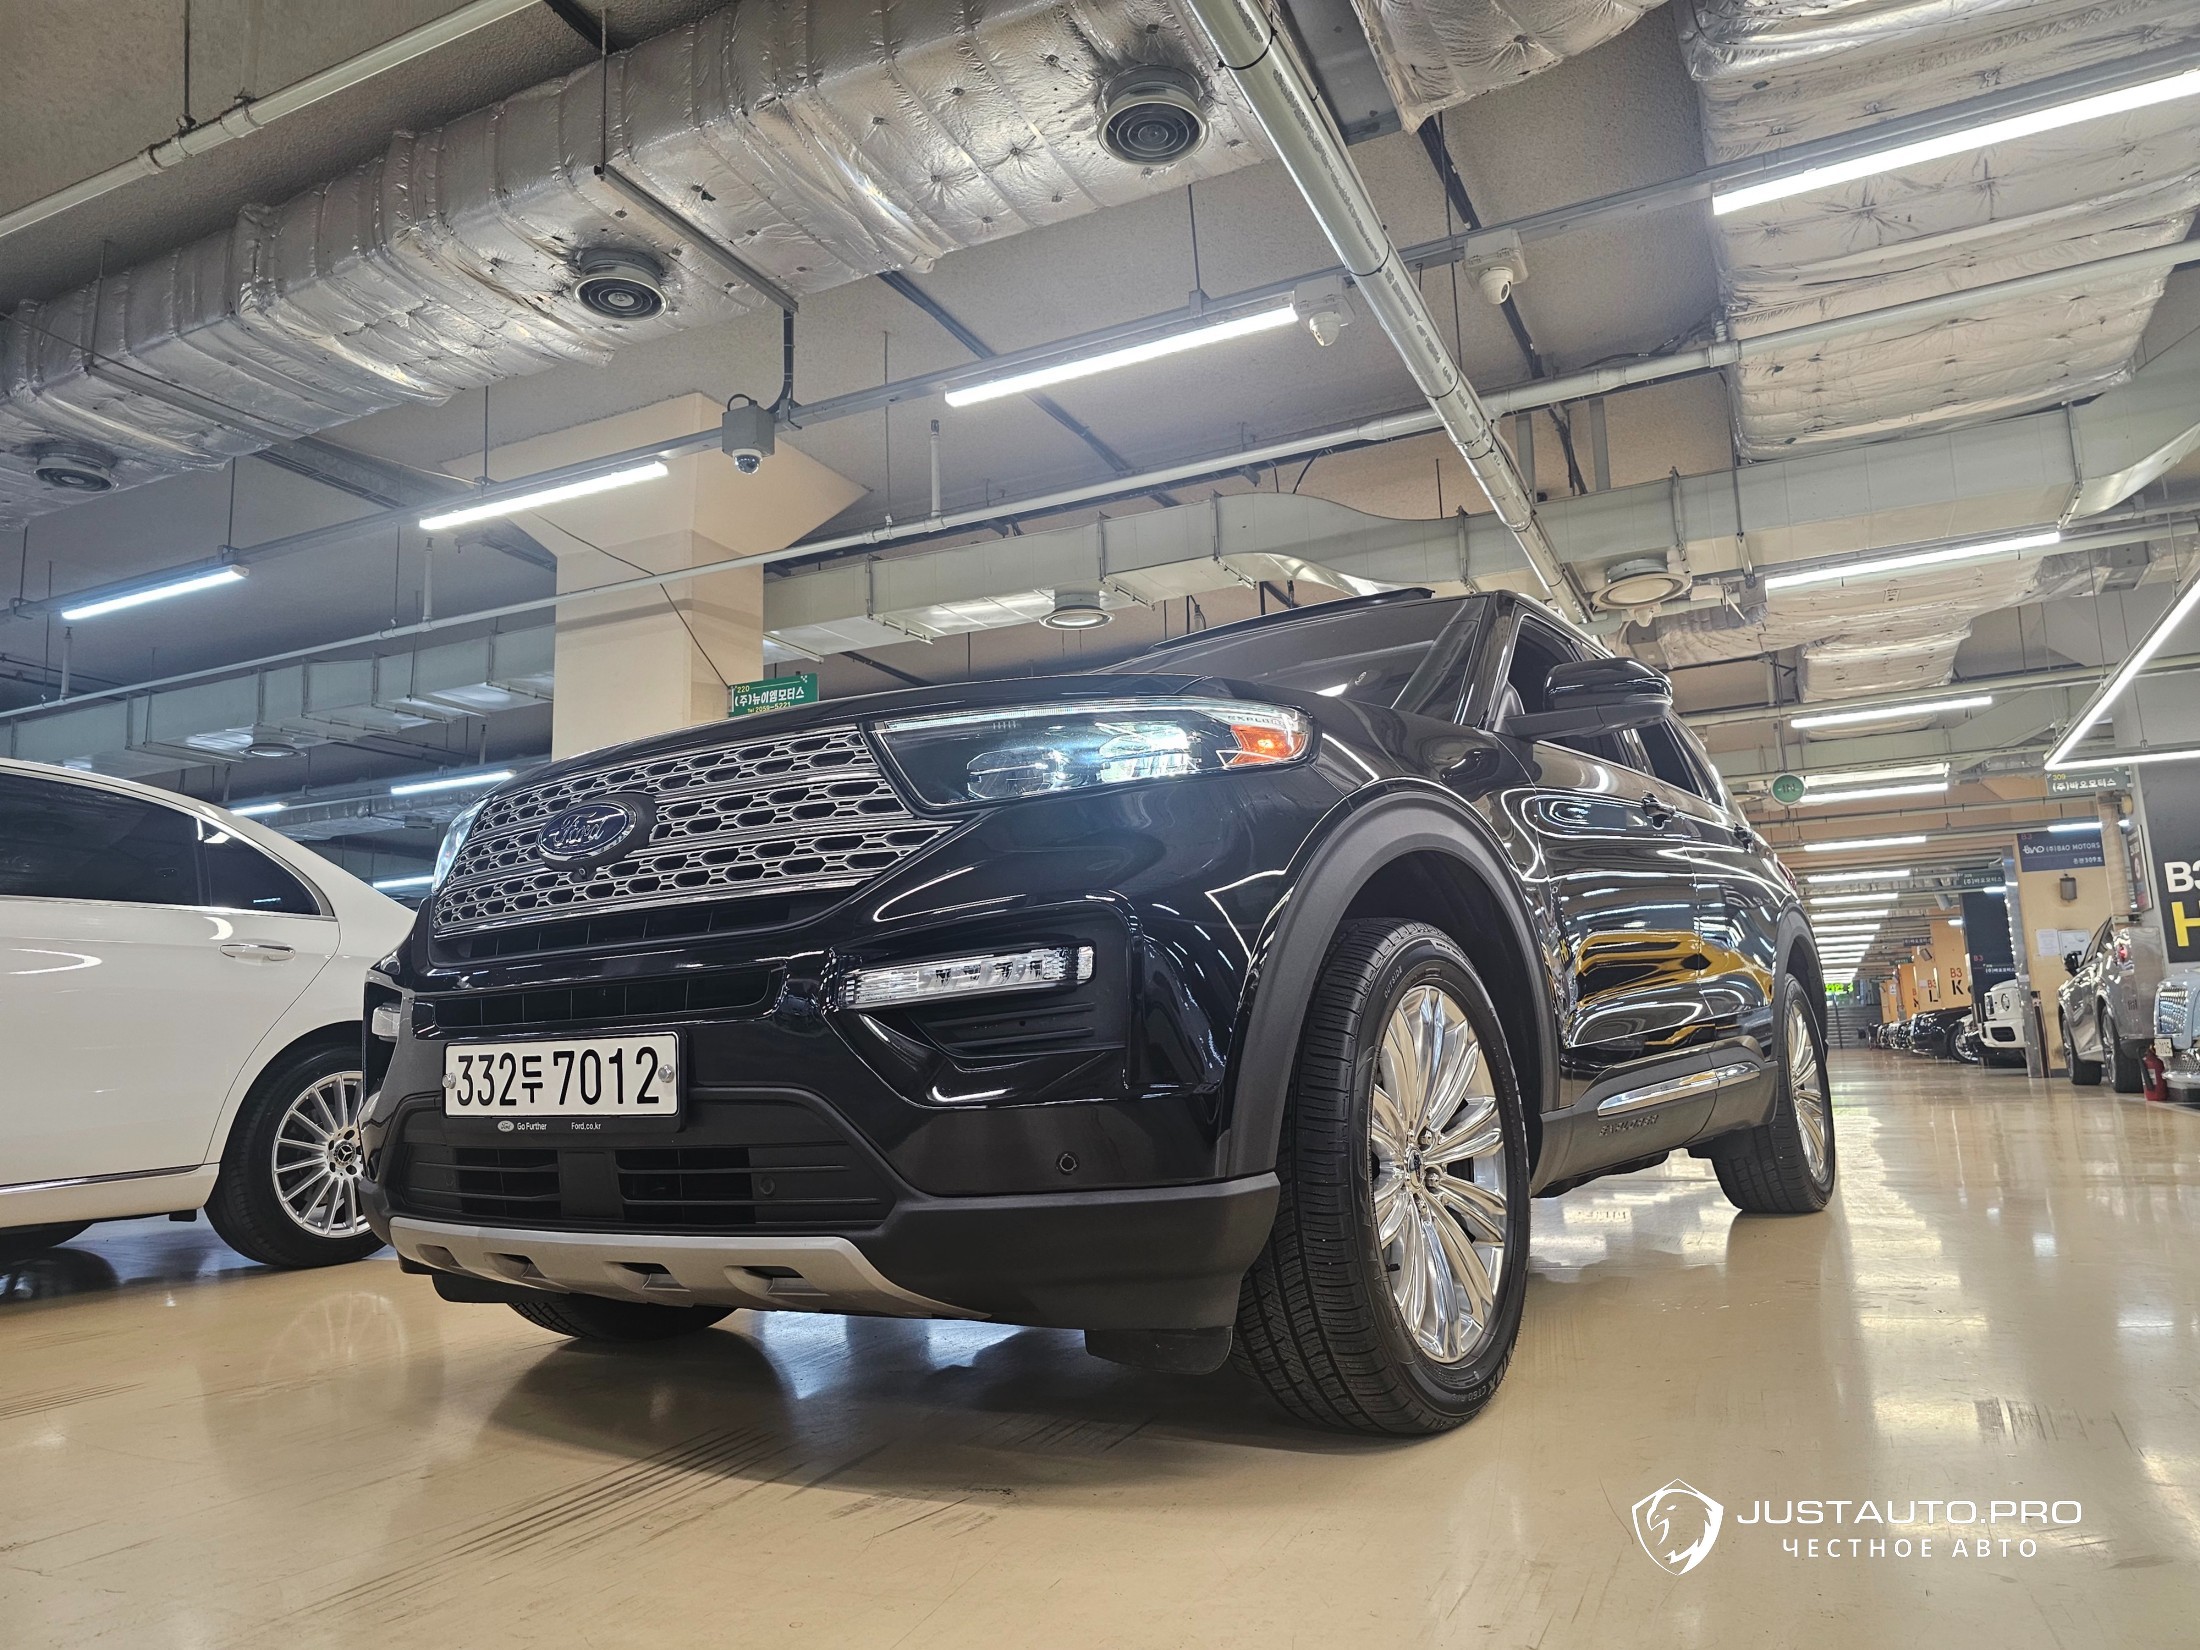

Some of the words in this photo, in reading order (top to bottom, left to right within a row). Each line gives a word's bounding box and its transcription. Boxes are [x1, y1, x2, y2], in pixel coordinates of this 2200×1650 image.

[735, 687, 805, 706] (주)뉴이엠모터스
[2052, 779, 2117, 792] (주)바오모터스
[2072, 842, 2101, 850] MOTORS
[1950, 967, 1963, 978] B3
[1383, 965, 1403, 999] OUTSIDE
[1951, 979, 1964, 995] K
[456, 1052, 544, 1107] 332두
[552, 1046, 660, 1106] 7012
[517, 1122, 525, 1130] Go
[526, 1122, 548, 1130] Further
[571, 1122, 602, 1130] Ford.co.kr
